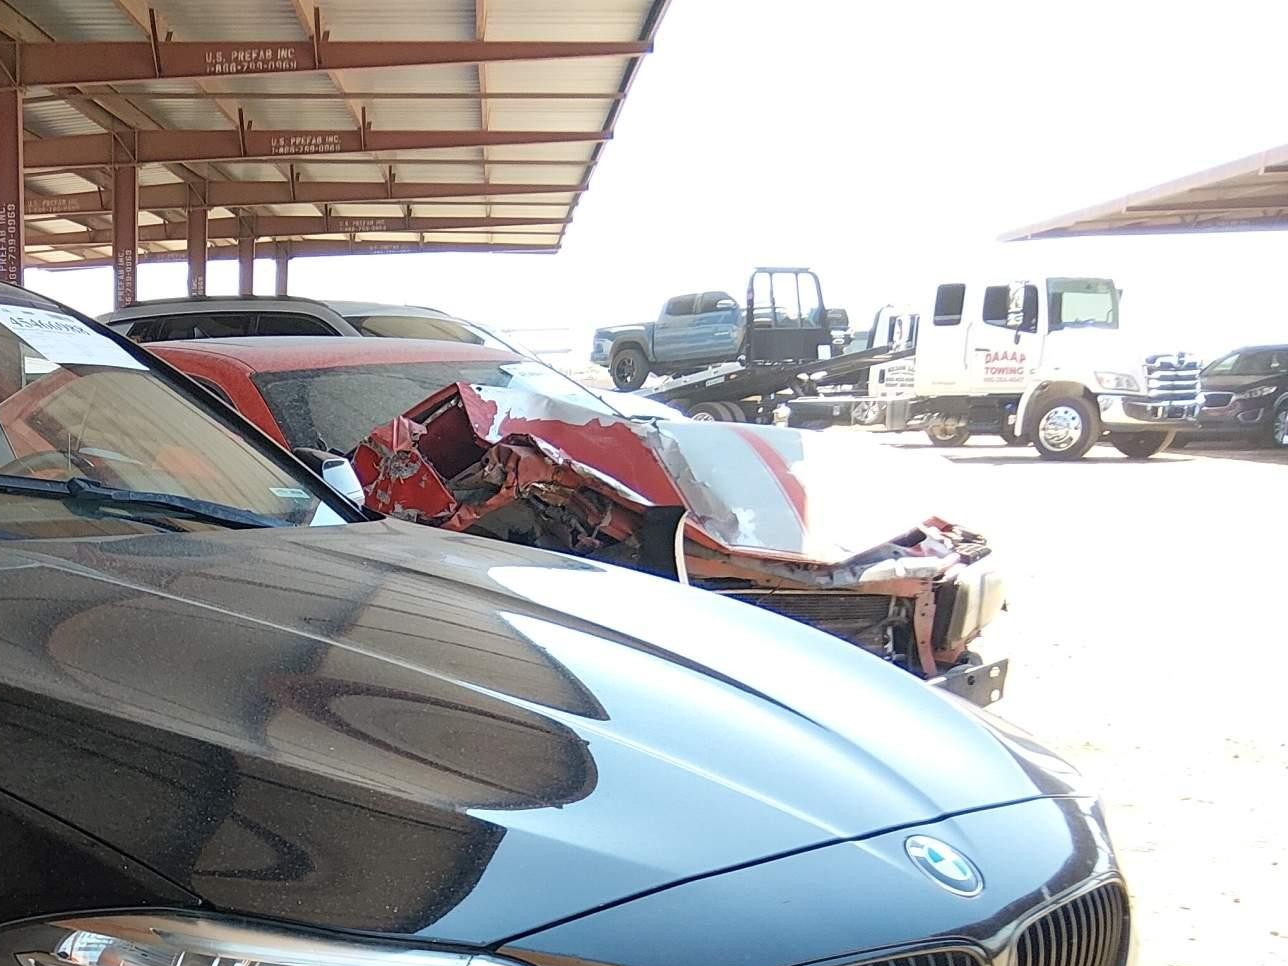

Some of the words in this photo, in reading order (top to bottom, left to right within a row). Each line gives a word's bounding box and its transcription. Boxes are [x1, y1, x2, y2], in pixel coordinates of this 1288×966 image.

[206, 51, 226, 63] U.S.
[232, 48, 273, 61] PREFAB
[984, 367, 1024, 375] TOWING
